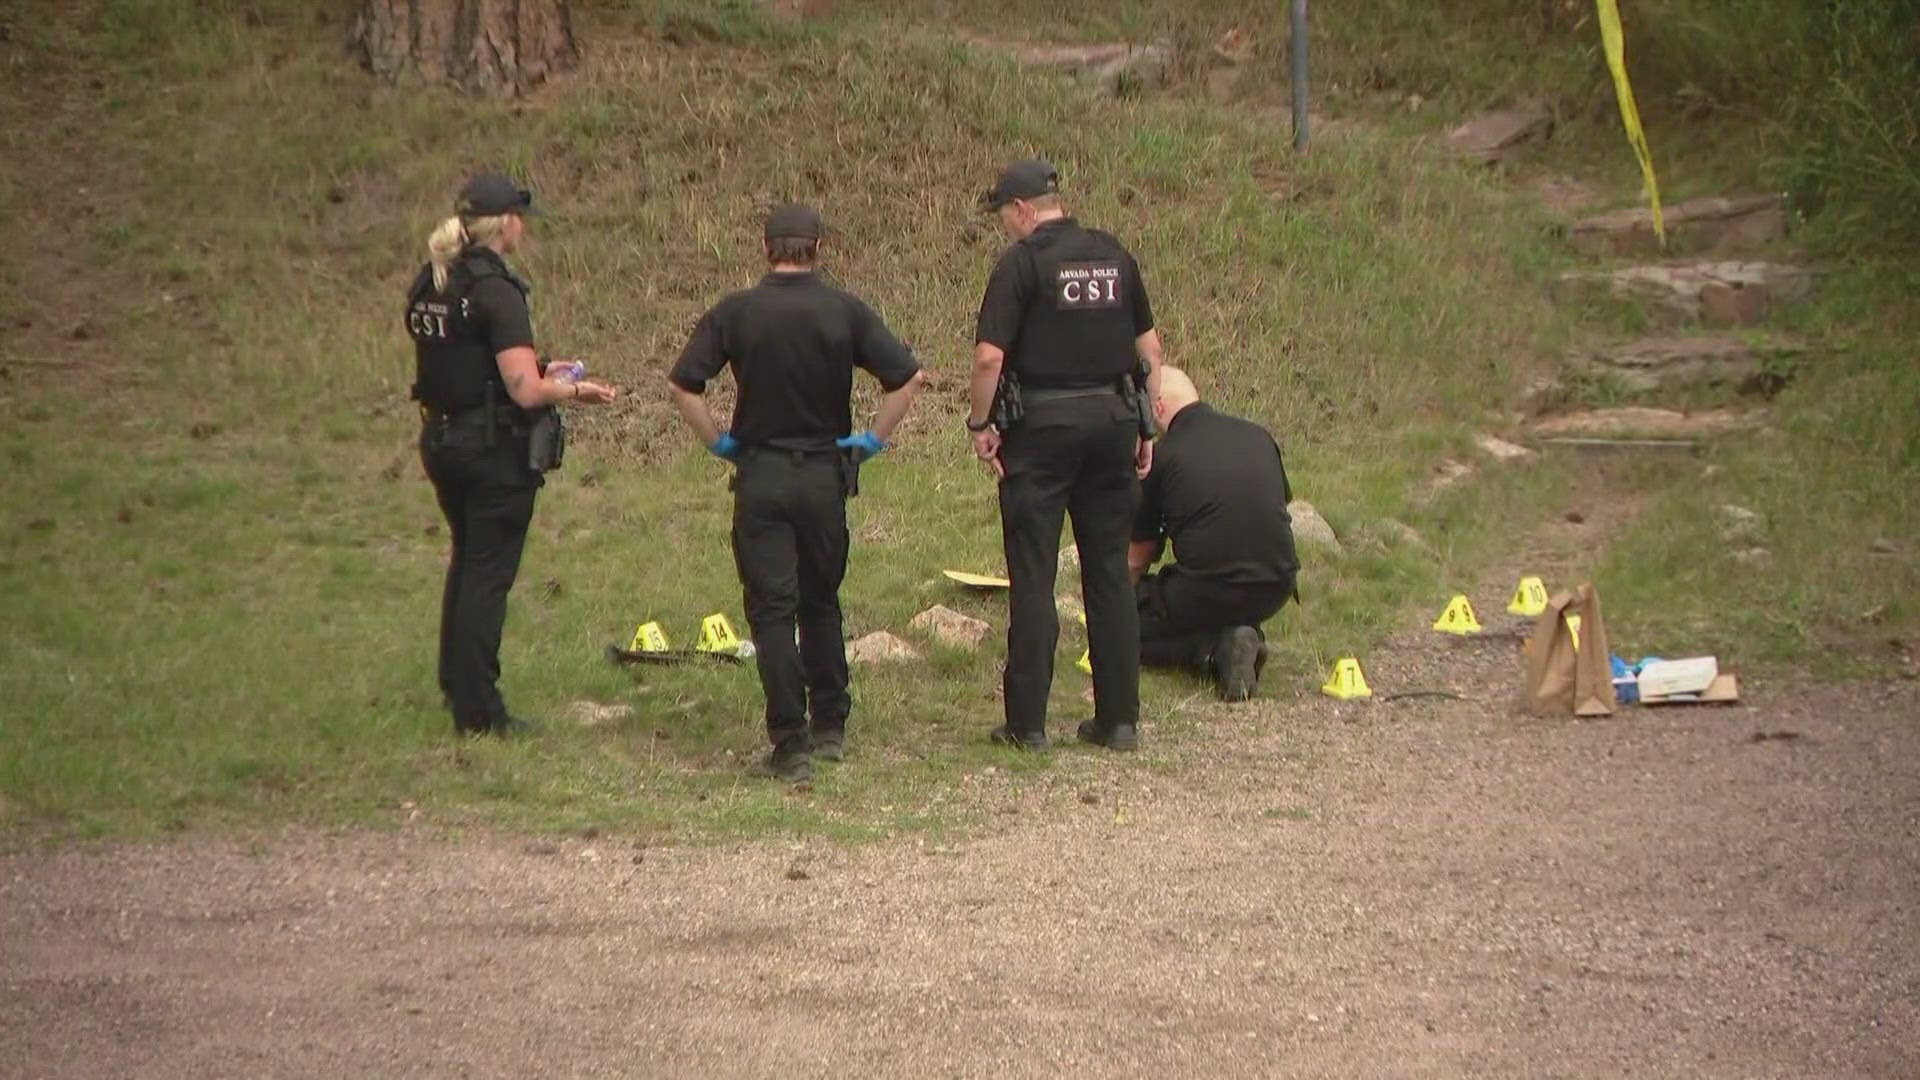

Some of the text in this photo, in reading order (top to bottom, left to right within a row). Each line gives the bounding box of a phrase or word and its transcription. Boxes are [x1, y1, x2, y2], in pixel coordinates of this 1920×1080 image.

[1059, 268, 1119, 279] ARVADA POLICE
[1063, 279, 1116, 302] CSI
[410, 312, 446, 337] CSI
[1529, 585, 1543, 602] 10
[649, 631, 662, 650] 15
[712, 622, 728, 642] 14
[1347, 667, 1355, 686] 7
